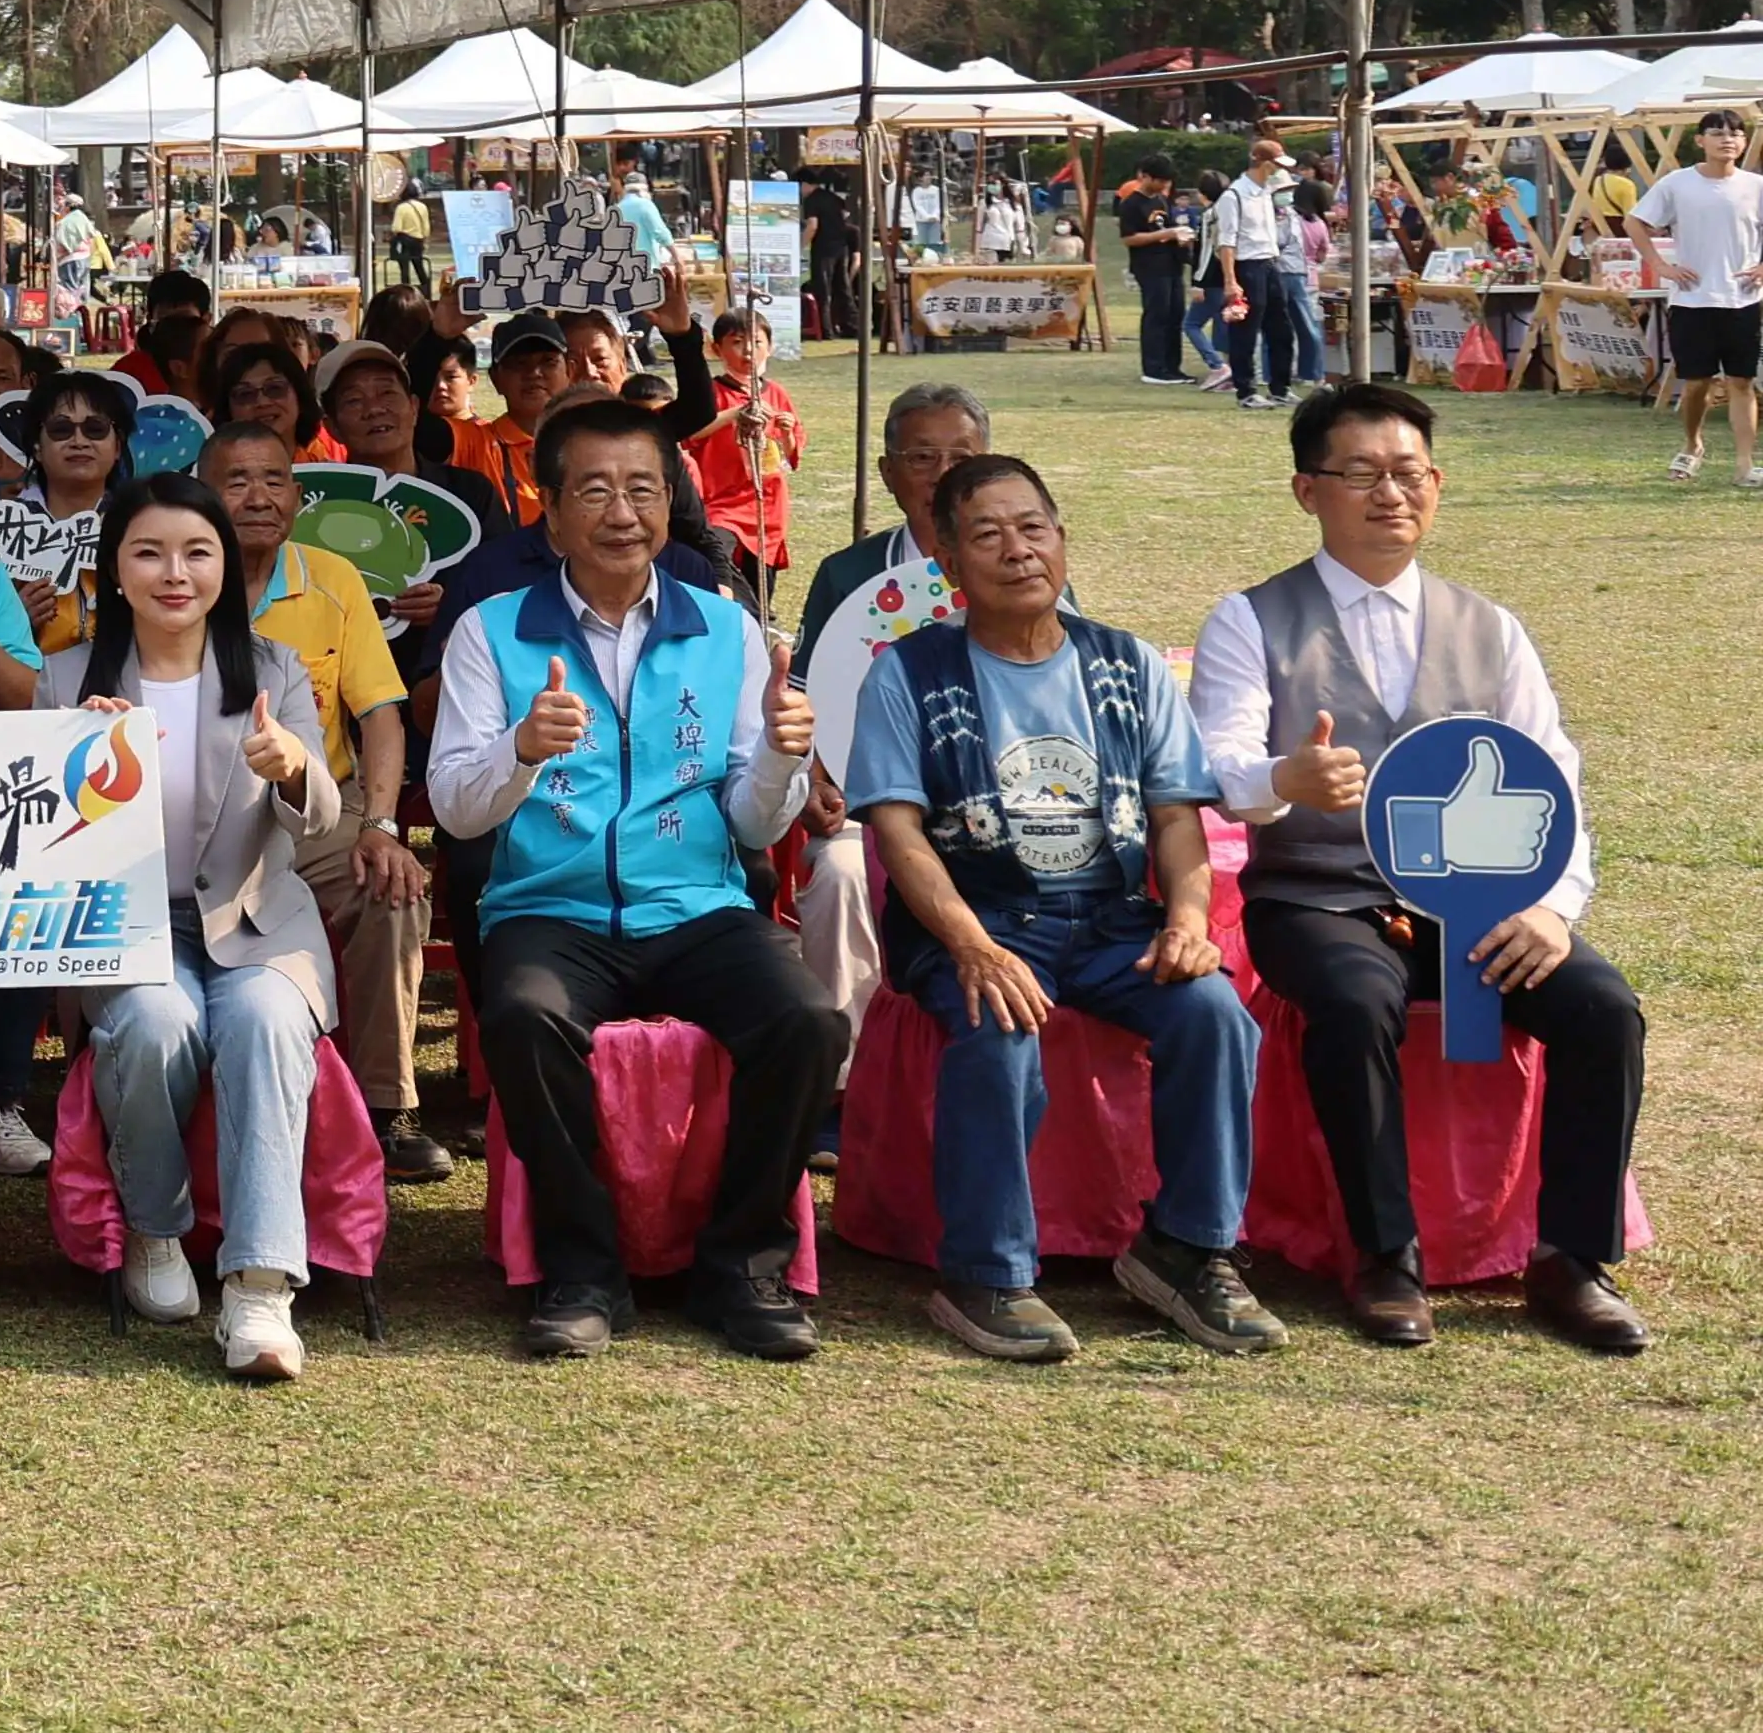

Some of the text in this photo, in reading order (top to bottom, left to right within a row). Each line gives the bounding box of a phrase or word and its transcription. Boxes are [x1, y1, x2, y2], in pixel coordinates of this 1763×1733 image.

[20, 564, 53, 579] Time
[656, 687, 707, 844] 大埤鄉所
[1029, 756, 1100, 798] ZEALAND
[57, 955, 121, 975] Speed
